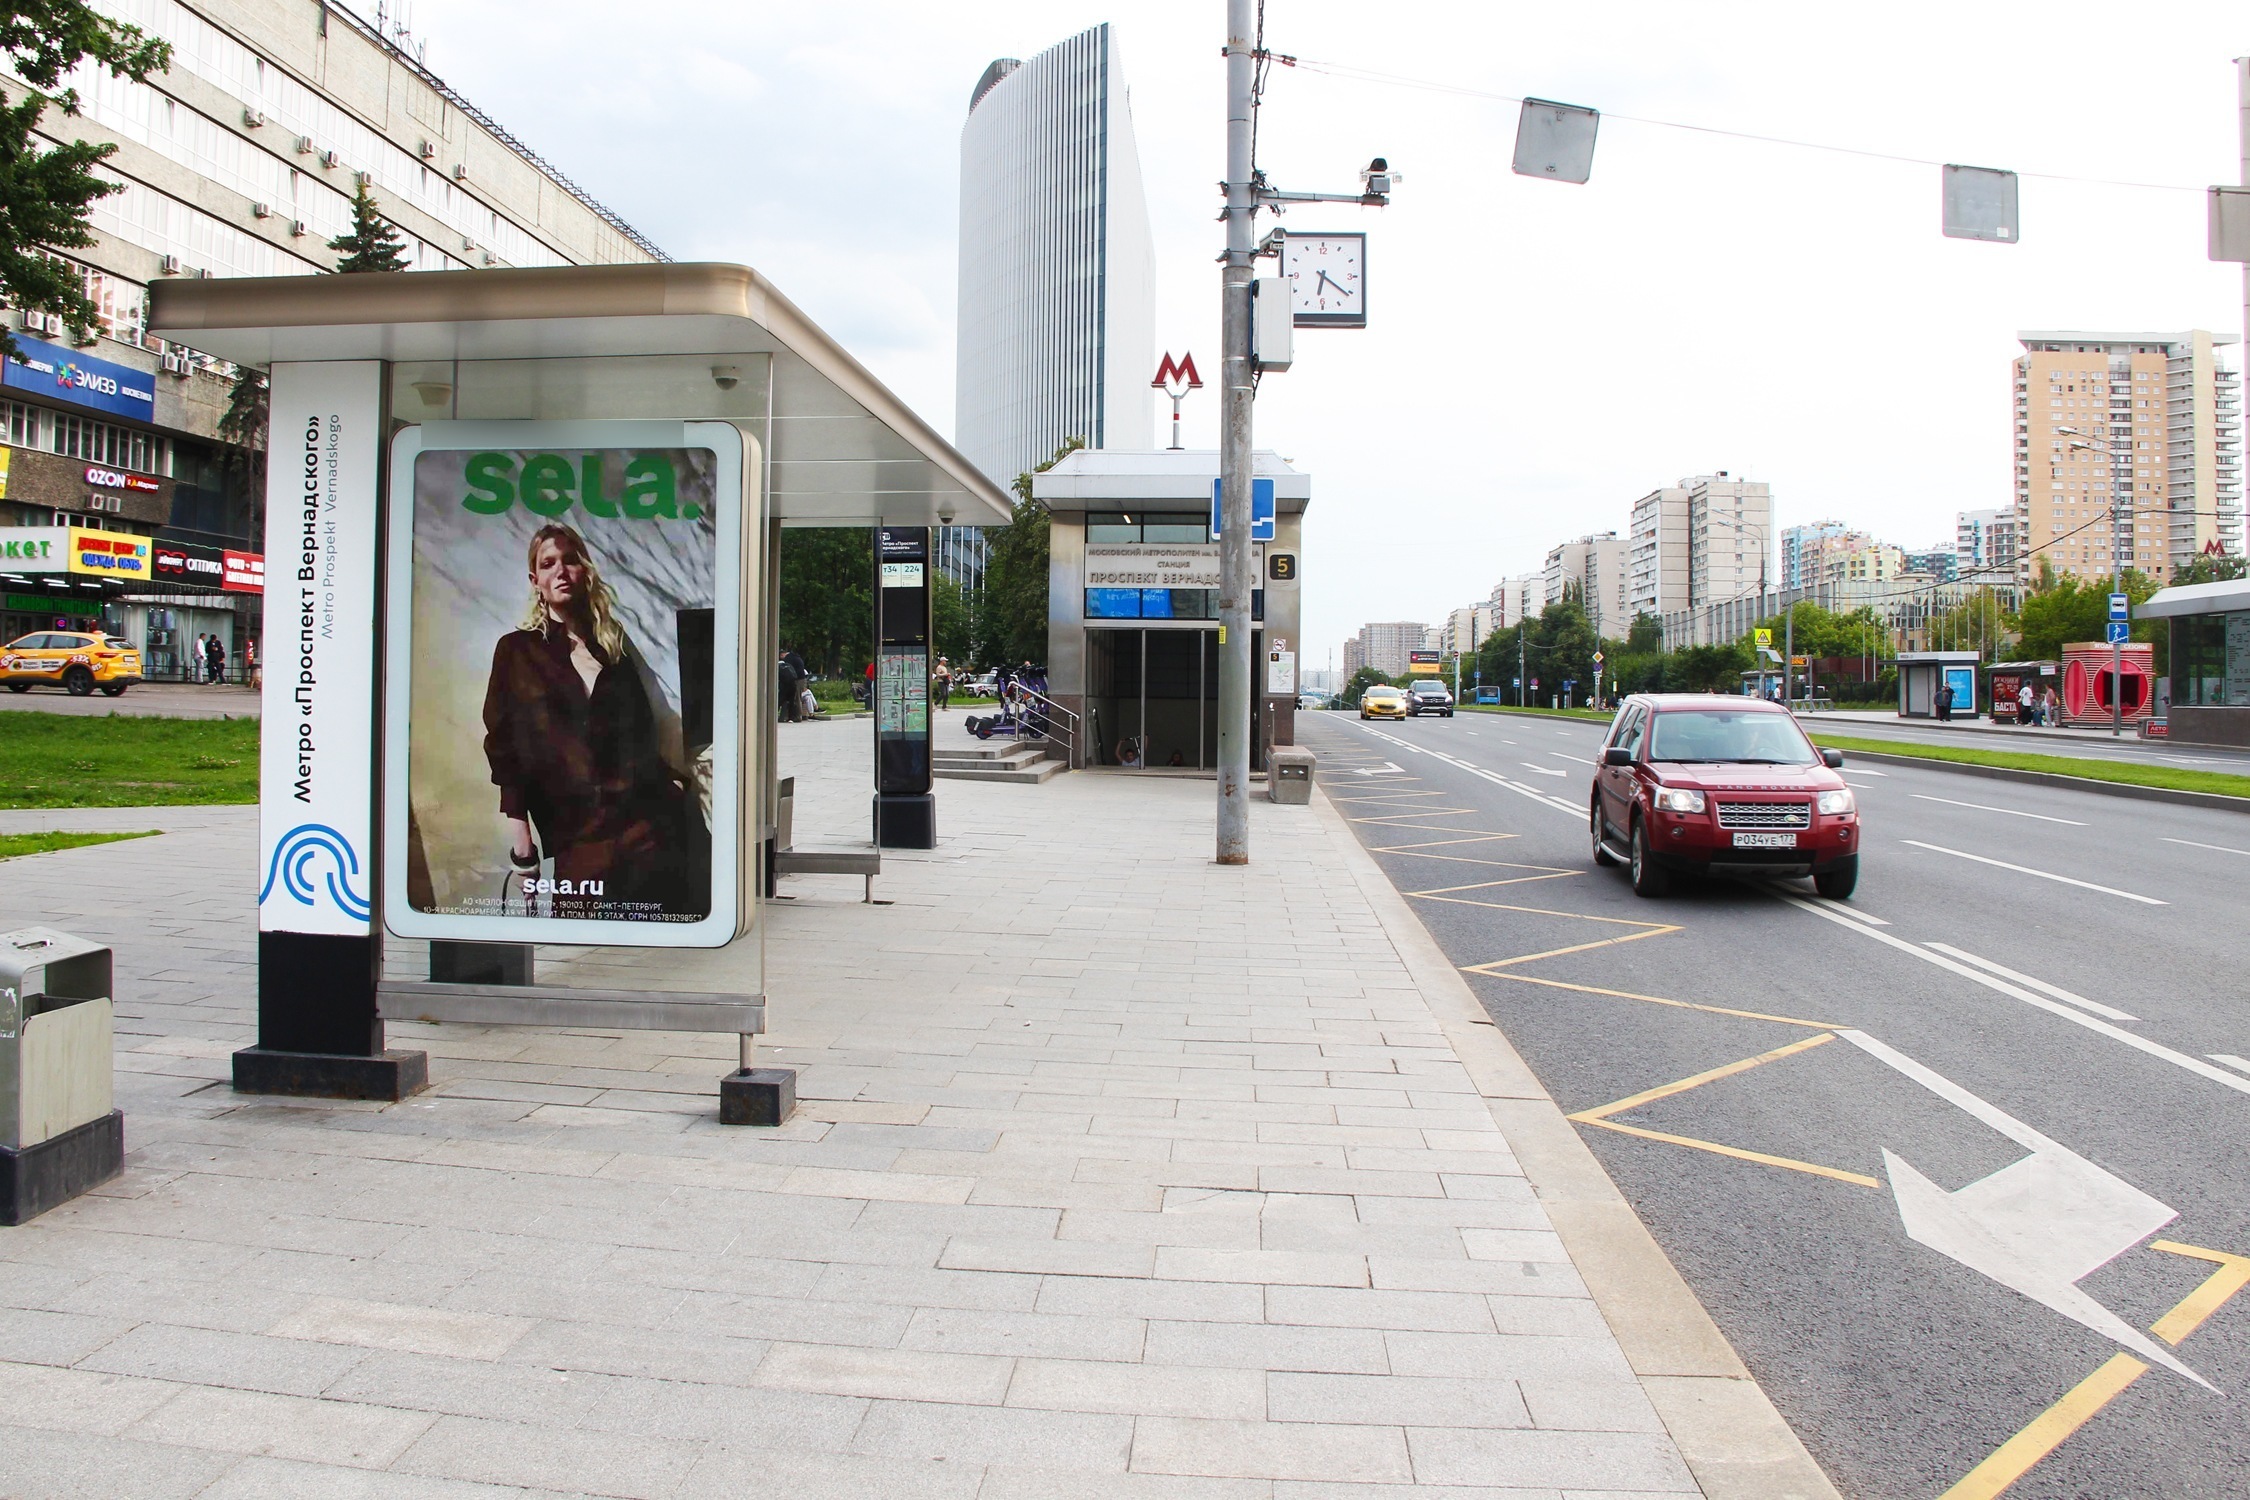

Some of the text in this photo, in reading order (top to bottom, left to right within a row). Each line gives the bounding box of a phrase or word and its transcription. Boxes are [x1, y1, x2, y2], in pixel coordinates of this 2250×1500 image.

[1293, 272, 1299, 280] 9
[1347, 273, 1353, 281] 3
[75, 369, 117, 396] ЭЛИЗЭ
[87, 468, 126, 488] OZON
[322, 414, 341, 639] Metro Prospekt Vernadskogo
[1088, 547, 1142, 557] МОСКОВСКИЙ
[1142, 549, 1200, 557] МЕТРОПОЛИТЕН
[82, 553, 142, 570] ОДЕЖДА ОБУВЬ
[185, 558, 224, 575] ОПТИКА
[1277, 558, 1289, 573] 5
[1089, 573, 1158, 584] ПРОСПЕКТ
[294, 415, 320, 804] Метро «Проспект Вернадского»
[1994, 702, 2017, 712] БАСТА
[523, 878, 604, 896] sela.ru
[462, 897, 473, 906] АО
